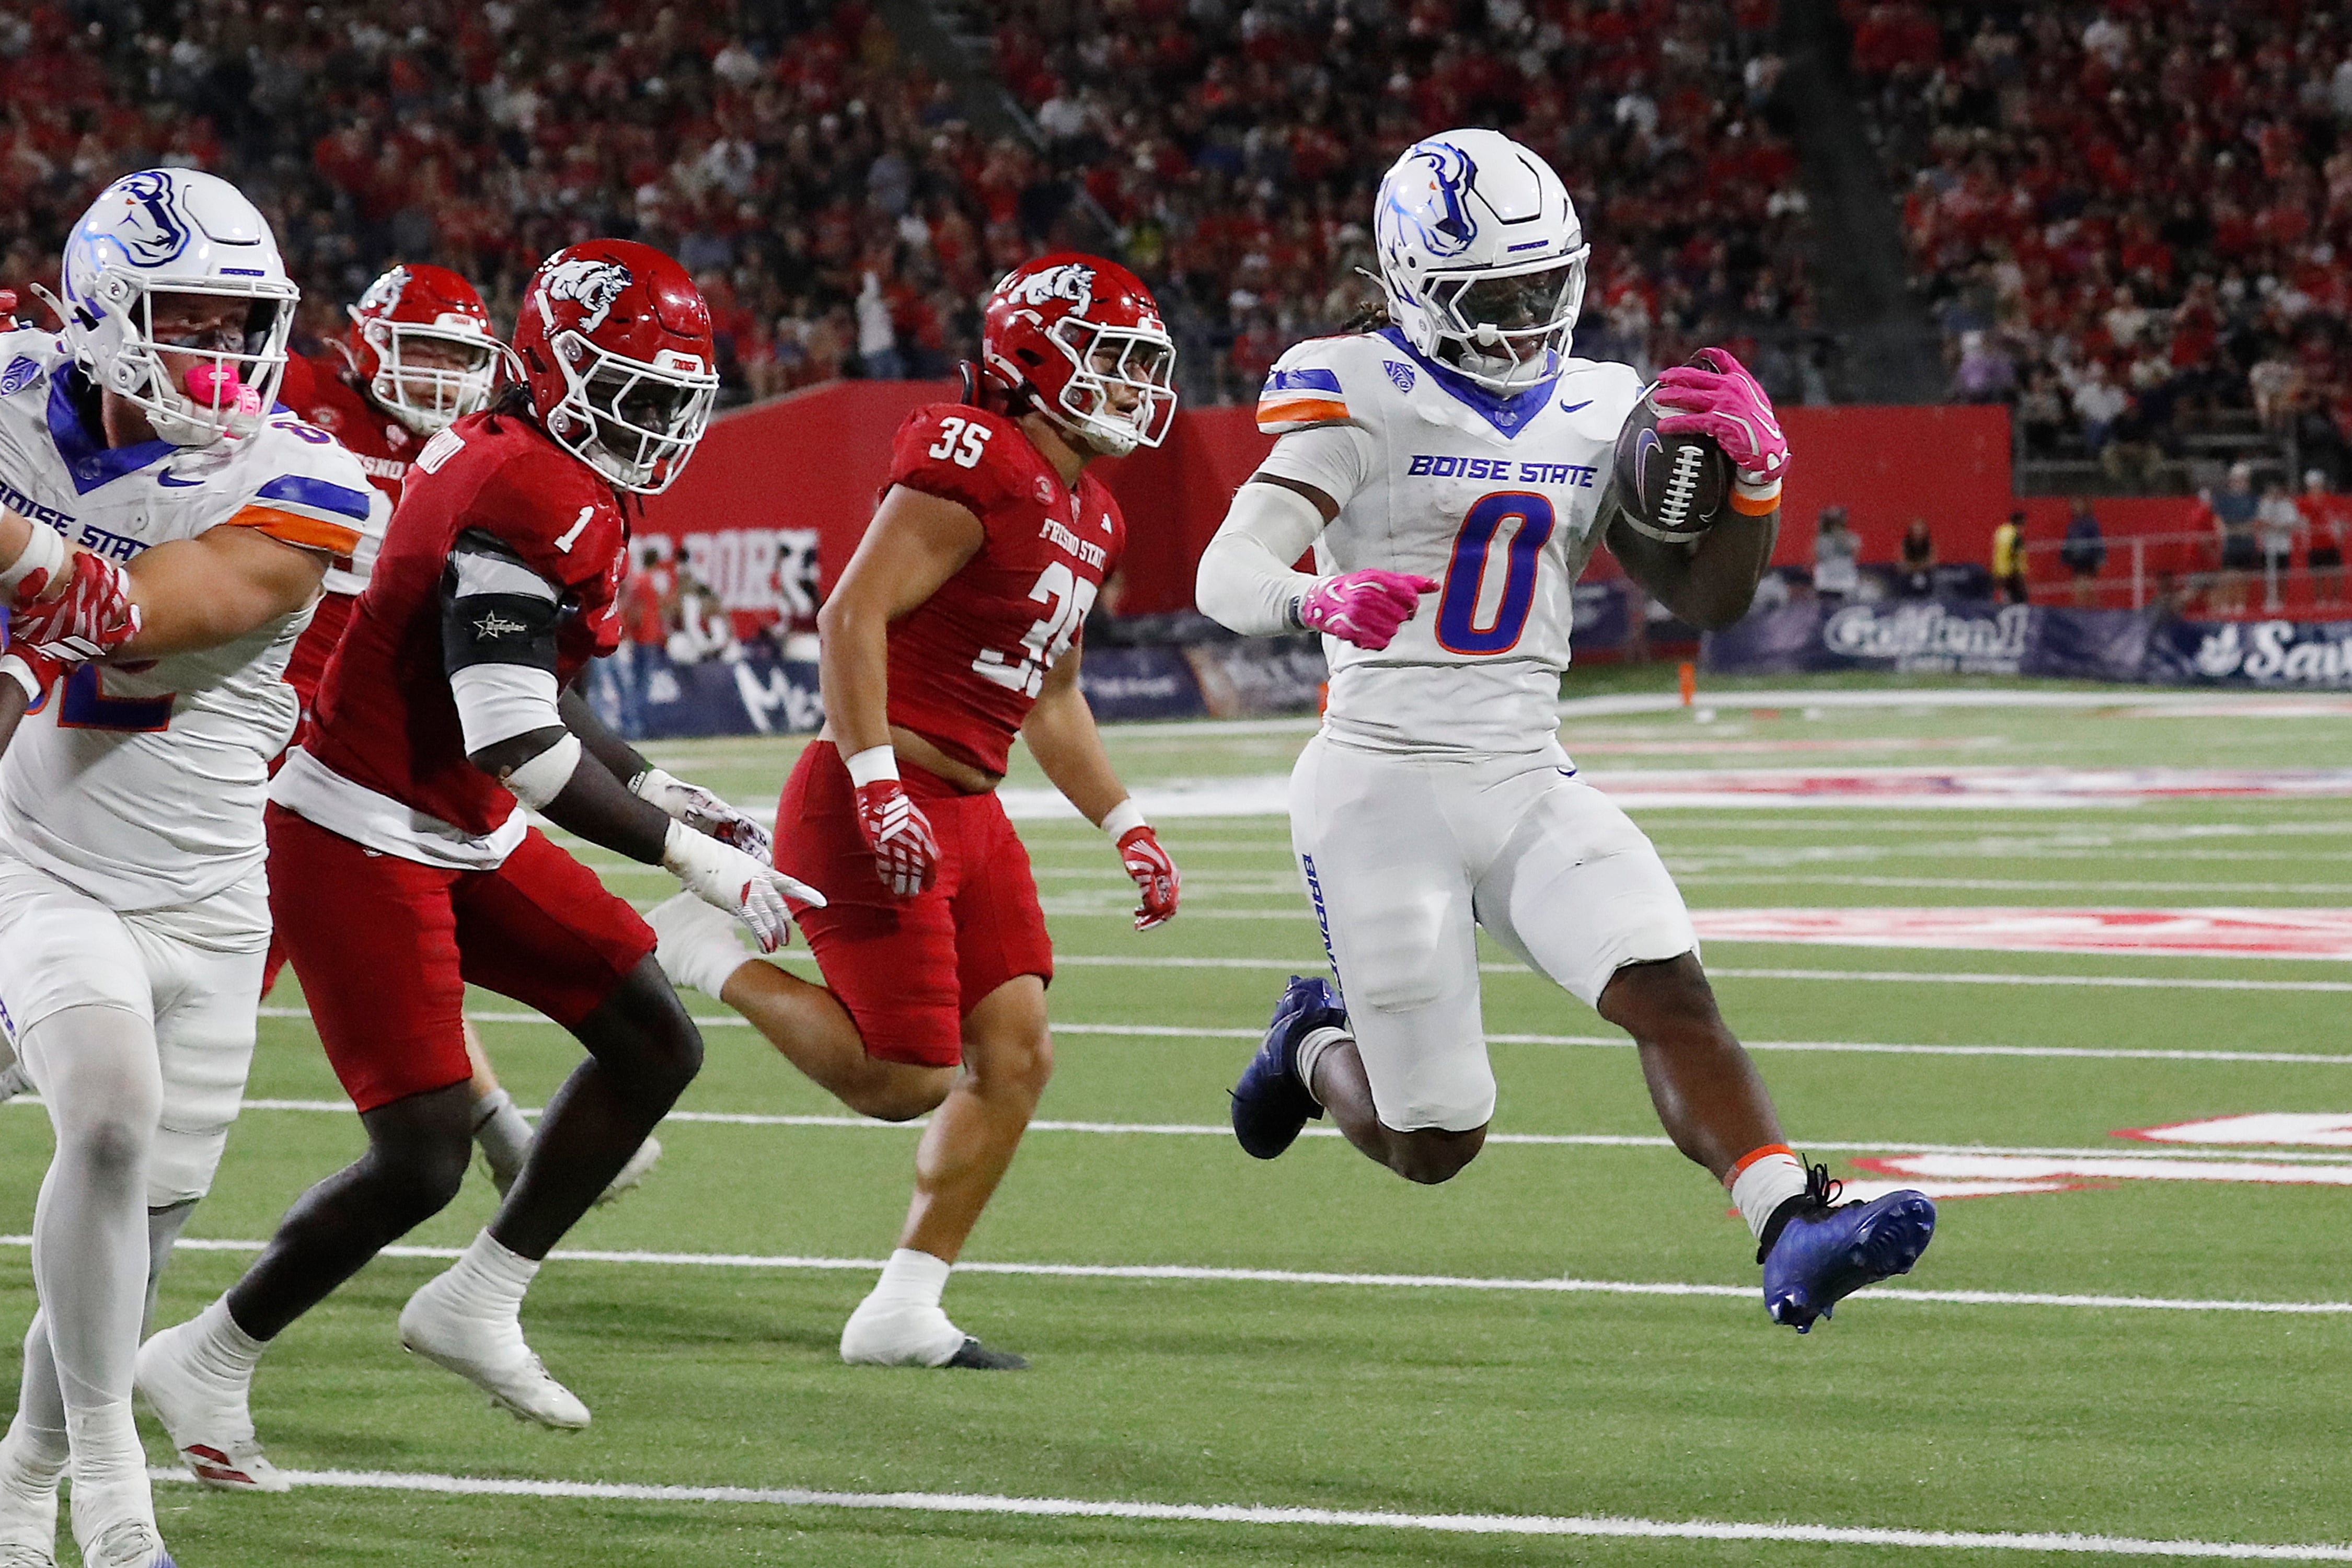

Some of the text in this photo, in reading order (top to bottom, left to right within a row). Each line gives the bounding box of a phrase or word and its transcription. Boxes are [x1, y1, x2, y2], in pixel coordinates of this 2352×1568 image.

[271, 421, 331, 443] 8
[928, 416, 993, 469] 35
[356, 453, 405, 480] SNO
[1408, 455, 1598, 488] BOISE STATE
[554, 505, 595, 554] 1
[1038, 517, 1108, 572] FRESNO STAT
[1434, 490, 1556, 656] 0
